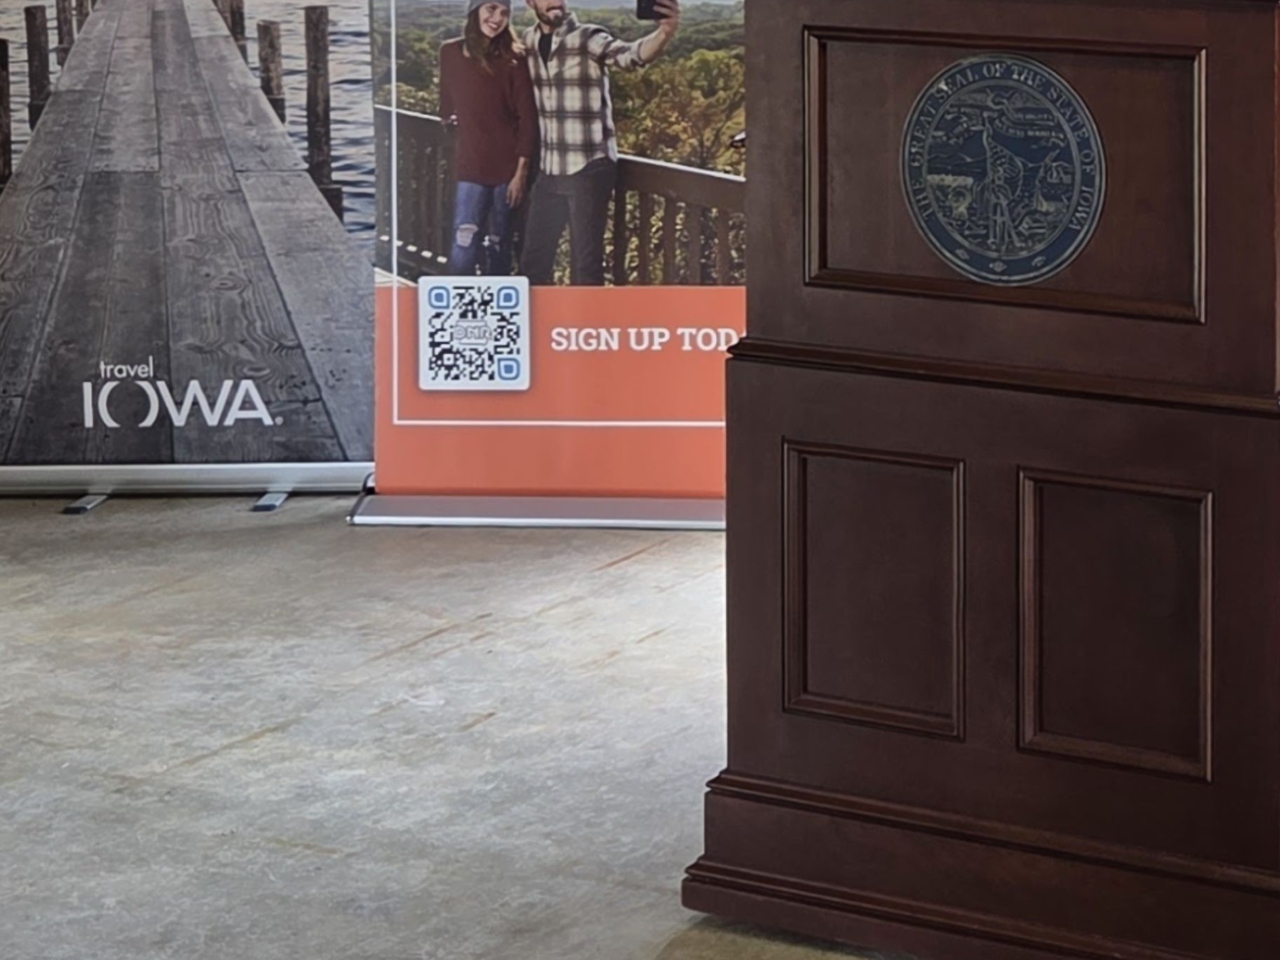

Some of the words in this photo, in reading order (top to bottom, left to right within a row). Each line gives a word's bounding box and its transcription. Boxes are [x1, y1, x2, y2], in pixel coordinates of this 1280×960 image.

[983, 62, 1004, 77] OF
[1011, 65, 1046, 89] THE
[933, 69, 979, 102] SEAL
[1047, 86, 1089, 142] STATE
[911, 101, 937, 167] GREAT
[1081, 149, 1095, 176] OF
[911, 178, 934, 221] THE
[1069, 186, 1094, 230] IOWA
[551, 327, 621, 351] SIGN
[627, 327, 670, 351] UP
[100, 355, 153, 378] travel
